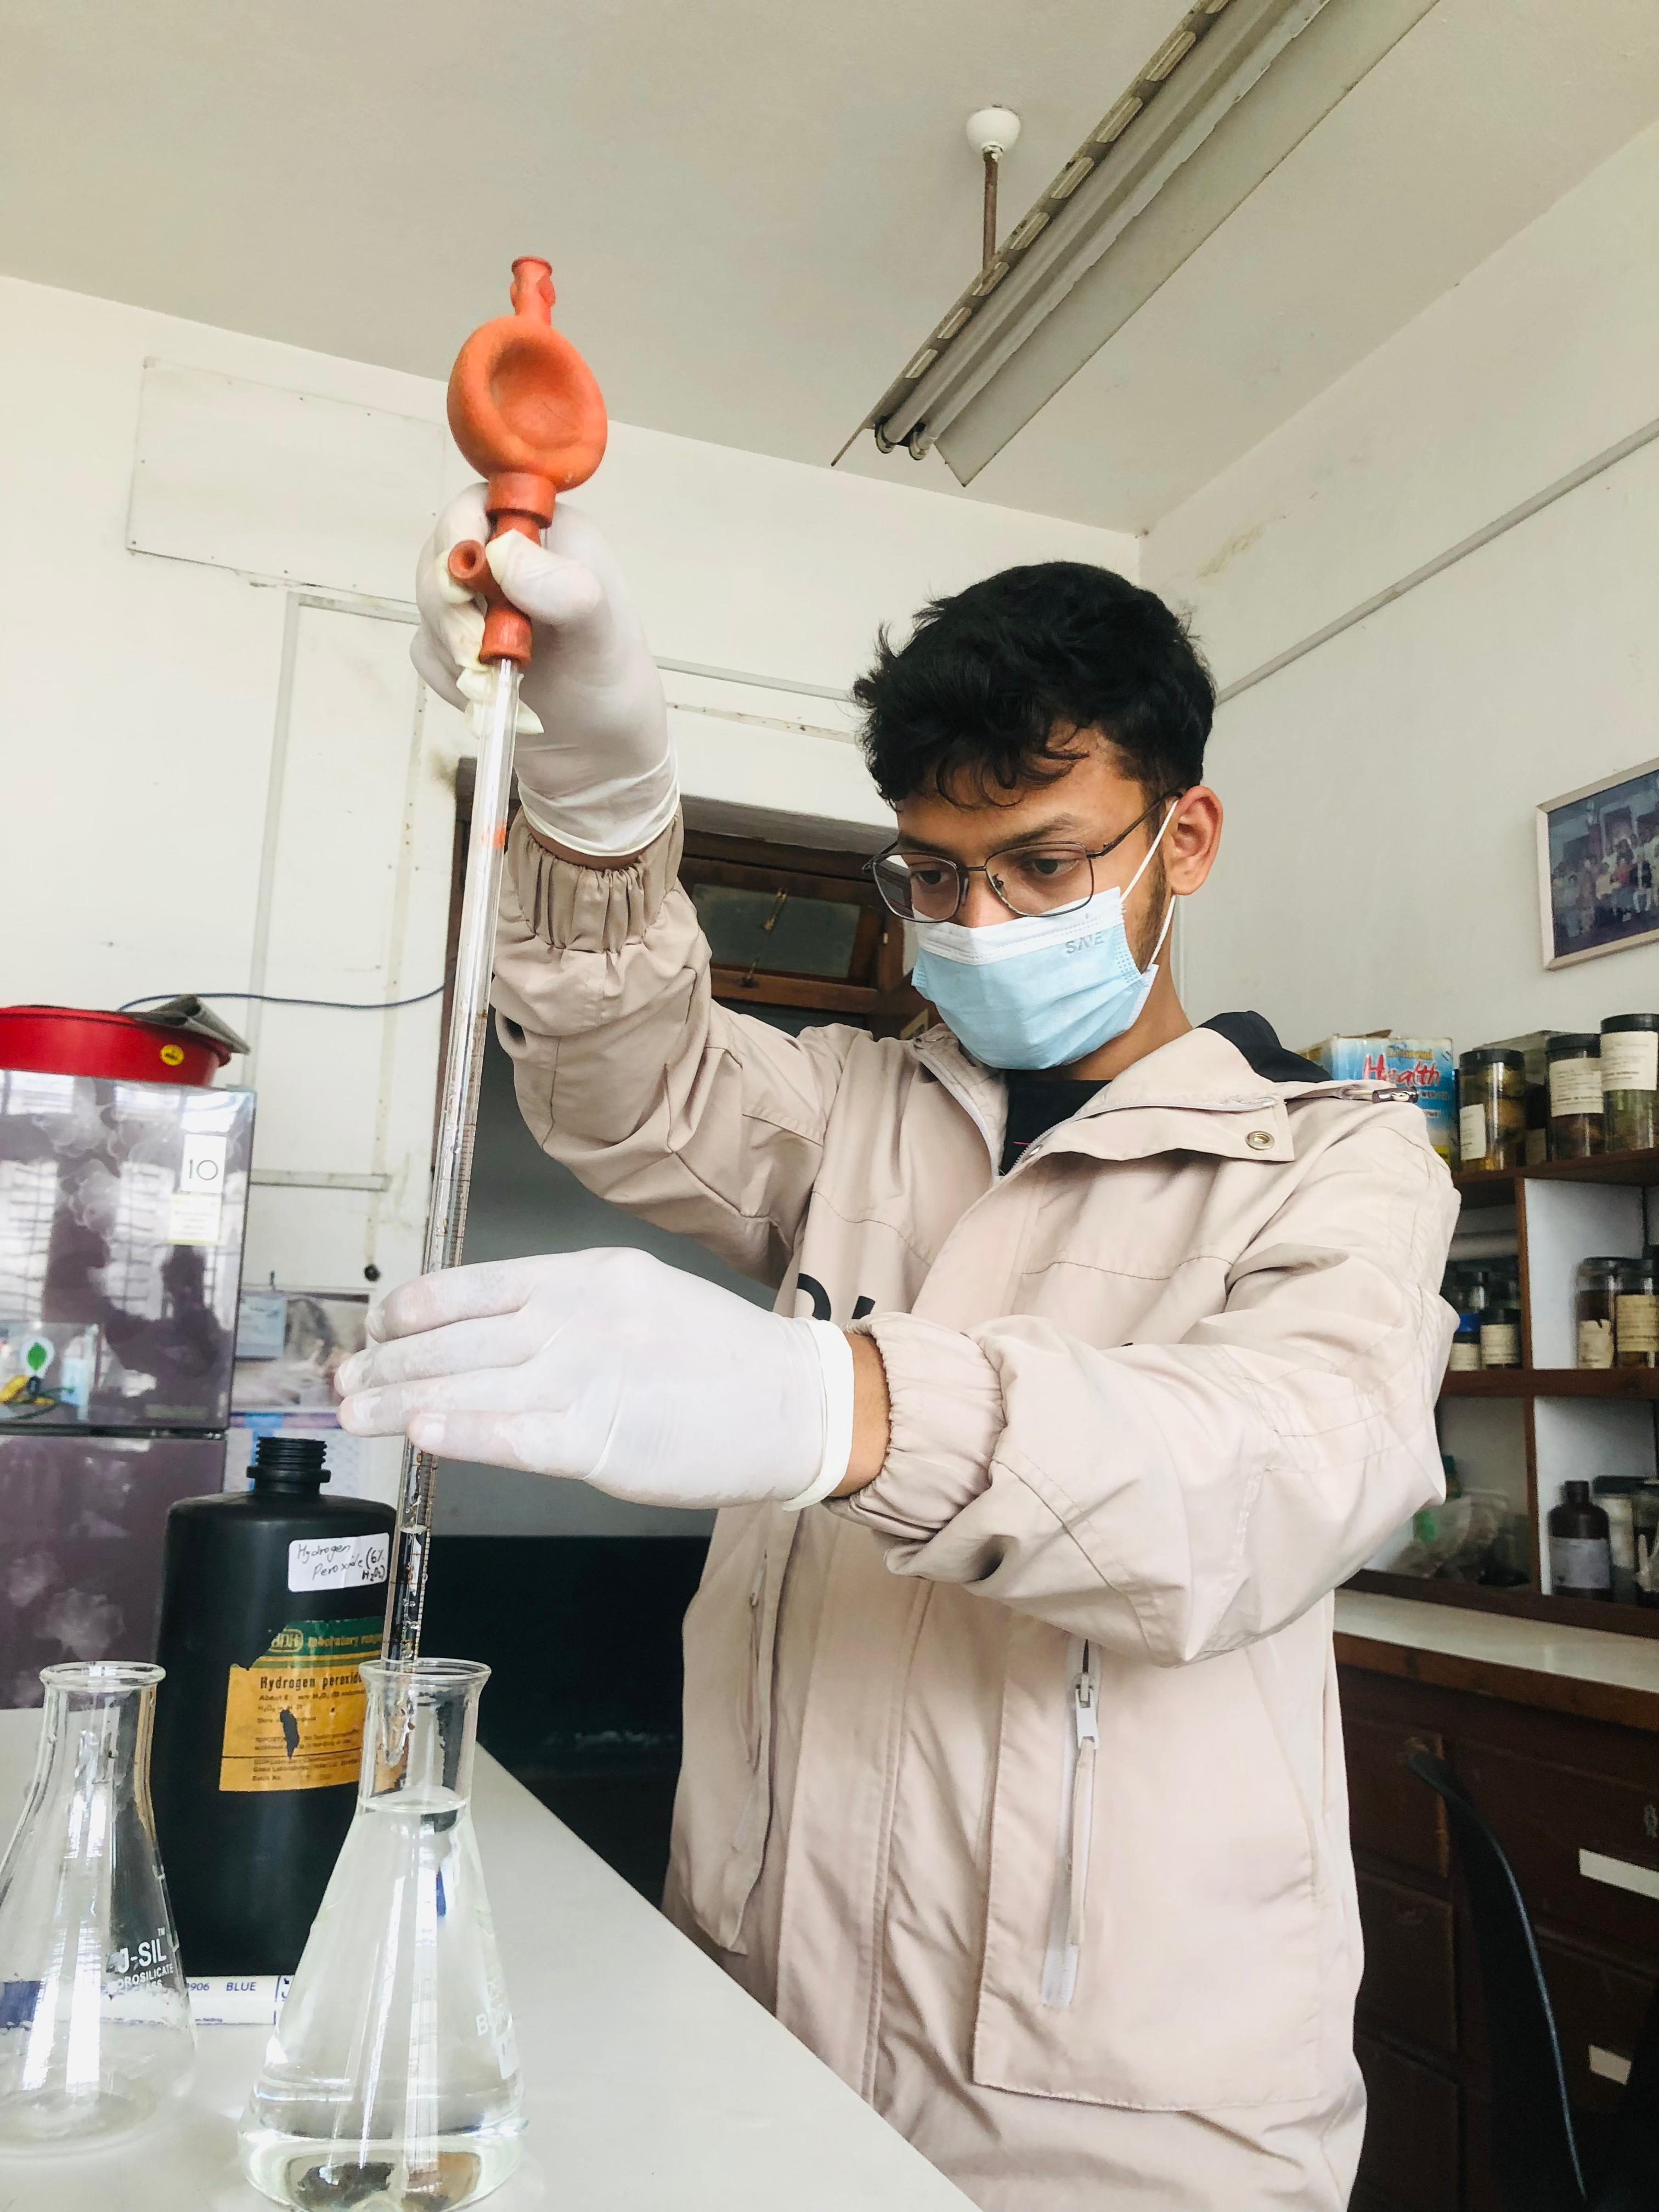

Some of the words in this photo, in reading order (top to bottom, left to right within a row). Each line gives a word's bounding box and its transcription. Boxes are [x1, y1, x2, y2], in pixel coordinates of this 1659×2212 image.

[297, 1544, 352, 1564] Hydrogen
[312, 1554, 363, 1581] Peroxide
[260, 1676, 316, 1692] Hydrogen
[117, 1938, 167, 1973] J-SIL
[111, 1963, 174, 1993] OROSILICATE
[225, 1982, 257, 1991] BLUE
